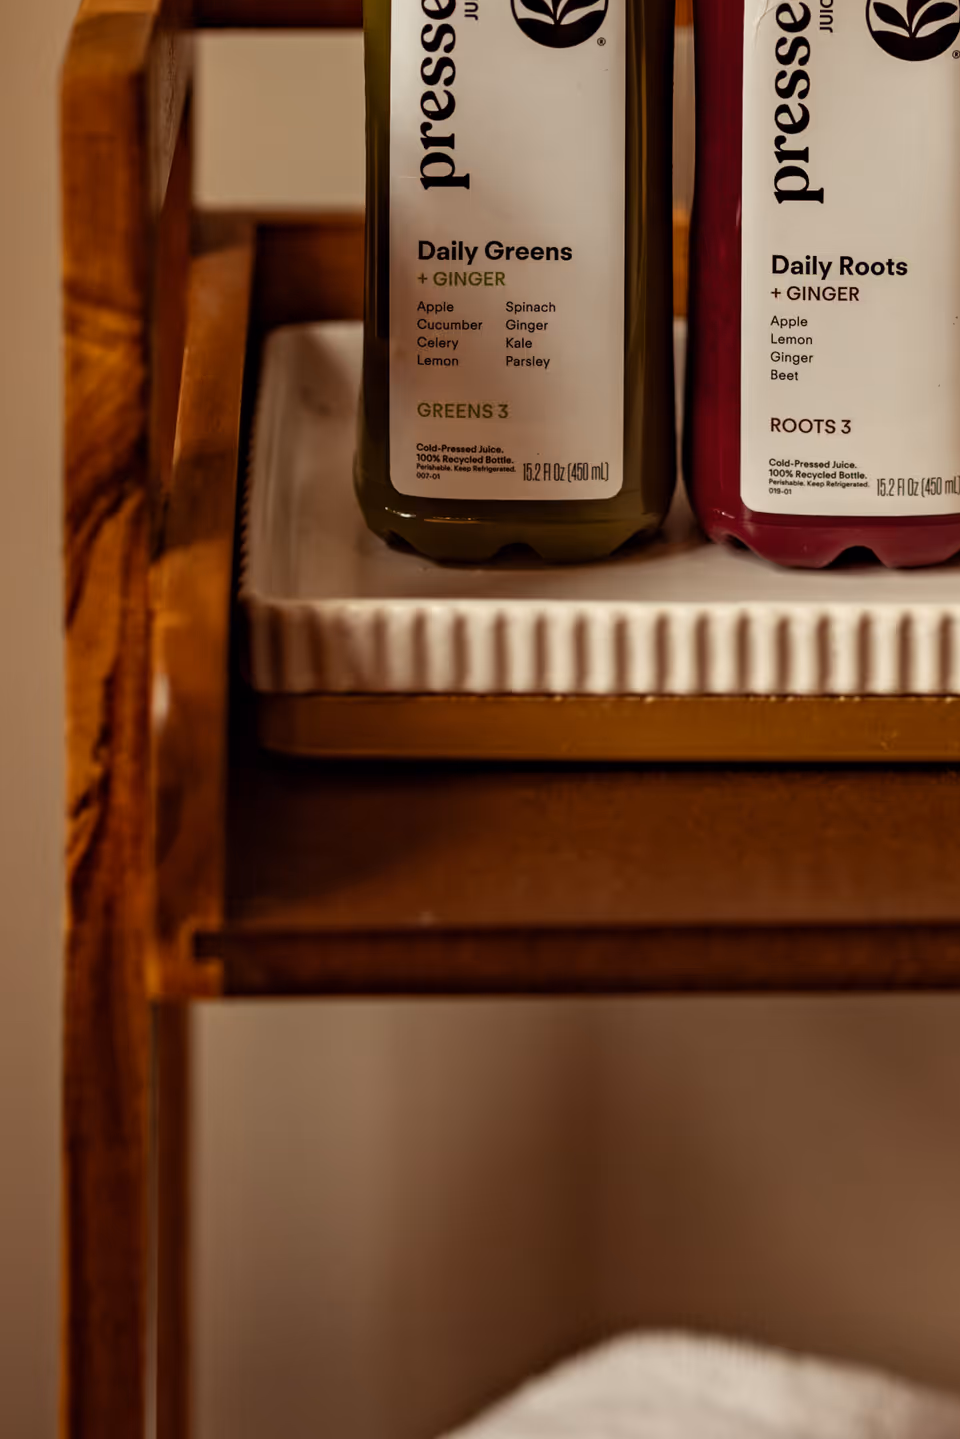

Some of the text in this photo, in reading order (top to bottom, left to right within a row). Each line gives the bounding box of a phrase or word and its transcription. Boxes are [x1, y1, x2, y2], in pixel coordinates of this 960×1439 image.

[418, 240, 573, 266] Daily Greens
[771, 255, 908, 280] Daily Roots
[417, 272, 506, 287] + GINGER
[770, 286, 860, 302] + GINGER
[416, 301, 455, 315] Apple
[505, 300, 556, 315] Spinach
[416, 318, 483, 331] Cucumber
[505, 318, 549, 334] Ginger
[770, 315, 809, 330] Apple
[416, 336, 459, 351] Celery
[505, 337, 533, 349] Kale
[770, 333, 813, 346] Lemon
[416, 355, 459, 367] Lemon
[505, 355, 551, 370] Parsley
[769, 351, 814, 366] Ginger
[770, 369, 799, 381] Beet
[416, 402, 509, 419] GREENS 3
[770, 417, 852, 435] ROOTS 3
[416, 443, 504, 454] Cold-Pressed Juice.
[416, 454, 514, 465] 100% Recycled Bottle.
[768, 458, 857, 469] Cold-Pressed Juice.
[416, 463, 452, 471] Perishable.
[473, 465, 516, 473] Refrigerated.
[523, 463, 541, 481] 15.2
[553, 463, 565, 481] Oz
[567, 462, 589, 482] (450
[591, 462, 609, 482] mL)
[768, 469, 867, 480] 100% Recycled Bottle.
[416, 472, 440, 480] 007-01
[768, 478, 870, 489] Perishable. Keep Refrigerated.
[876, 478, 894, 496] 15.2
[907, 478, 919, 496] Oz
[921, 477, 942, 497] (450
[768, 487, 792, 495] 019-01
